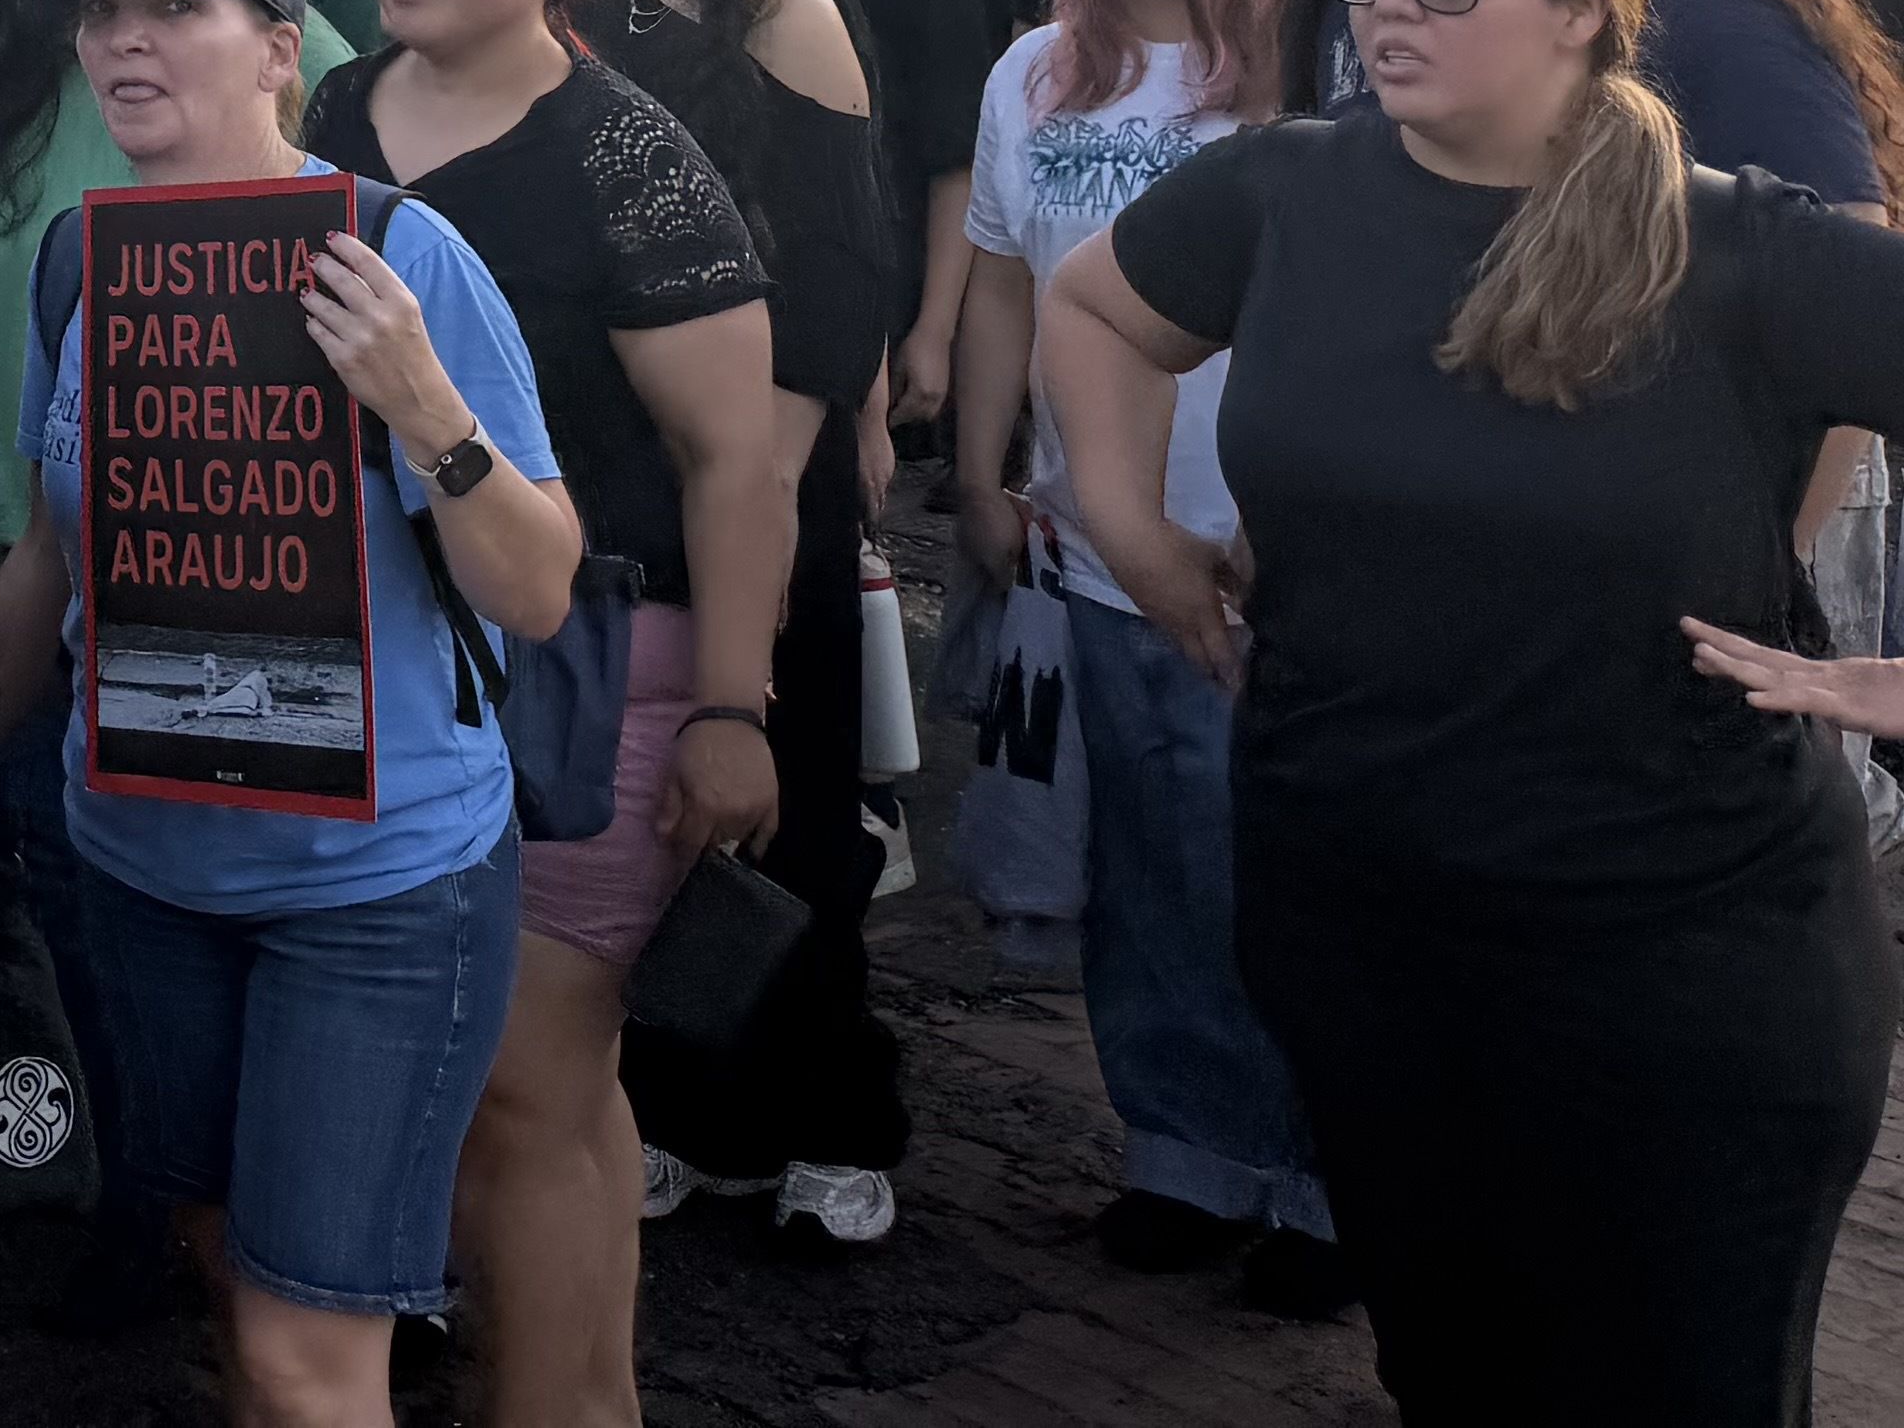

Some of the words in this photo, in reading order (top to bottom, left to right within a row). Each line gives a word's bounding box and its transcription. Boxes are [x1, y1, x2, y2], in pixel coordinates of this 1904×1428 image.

[107, 237, 316, 297] JUSTICIA
[107, 313, 238, 368] PARA
[107, 385, 324, 441] LORENZO
[107, 457, 337, 518] SALGADO
[110, 529, 310, 593] ARAUJO
